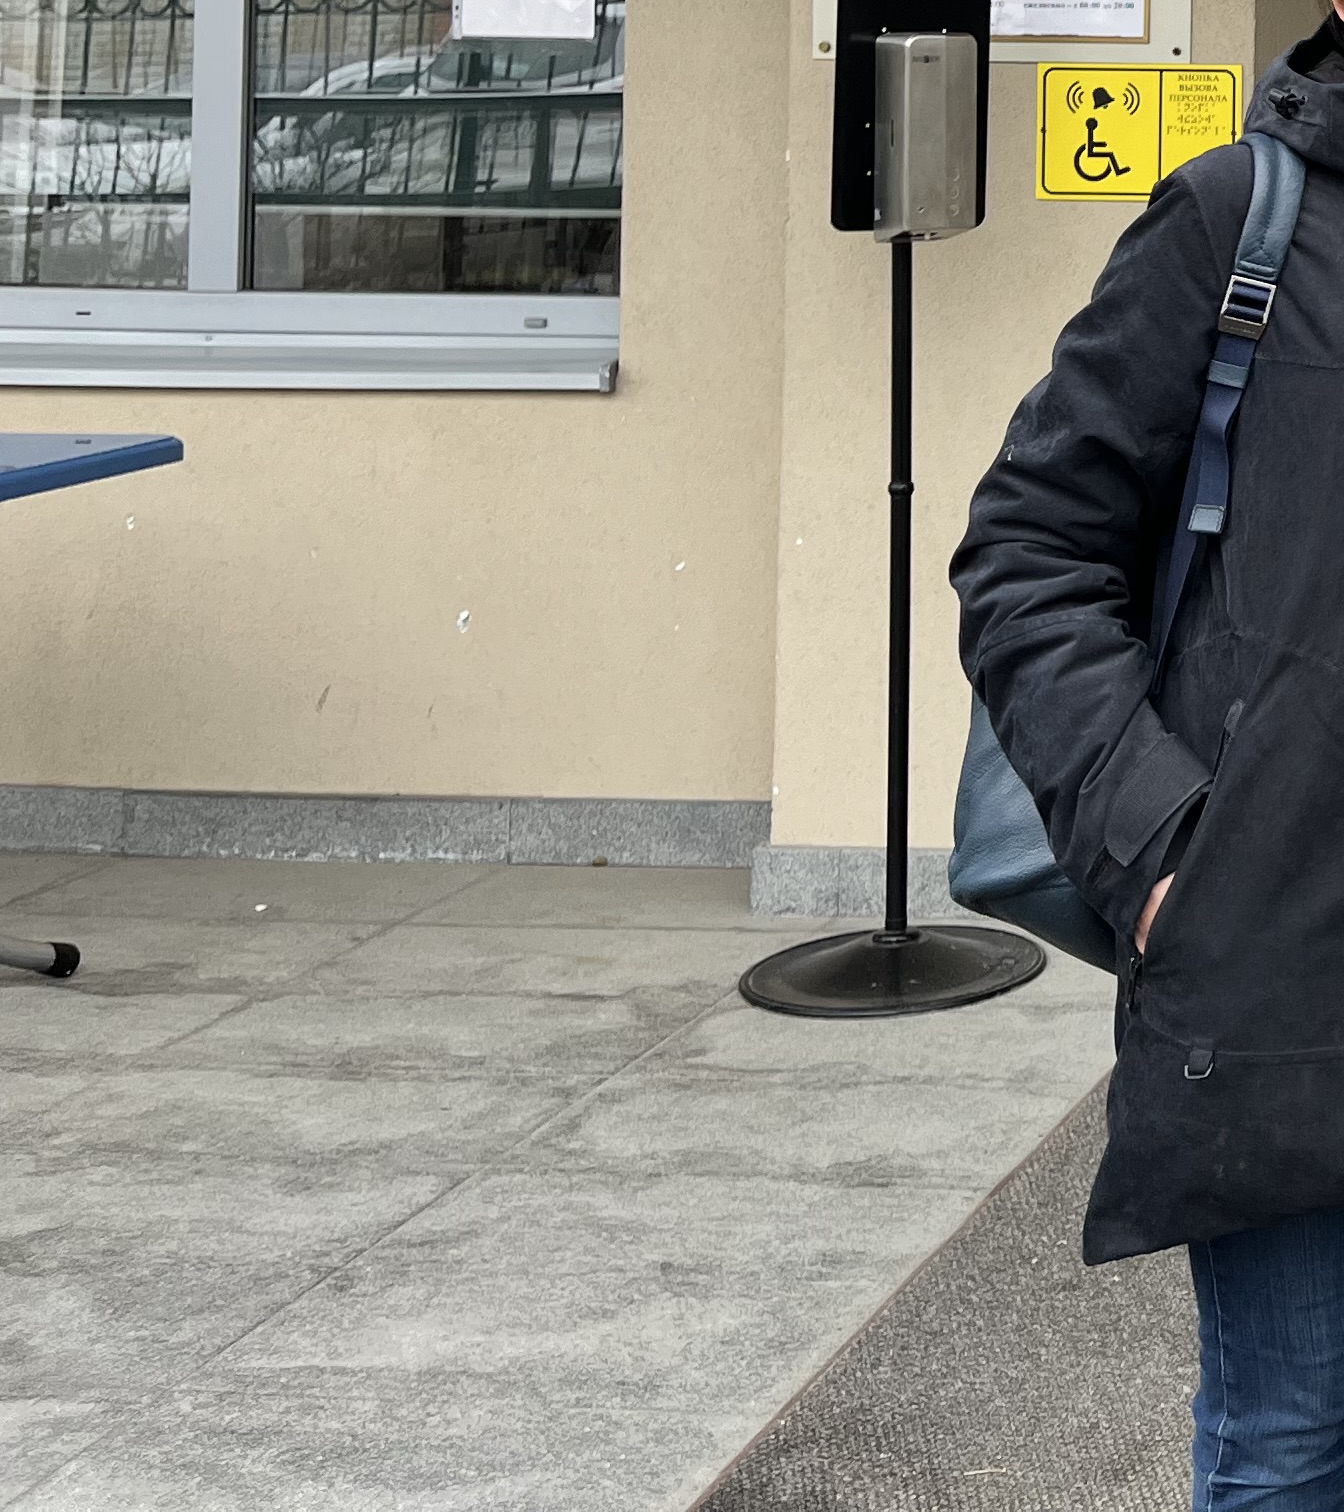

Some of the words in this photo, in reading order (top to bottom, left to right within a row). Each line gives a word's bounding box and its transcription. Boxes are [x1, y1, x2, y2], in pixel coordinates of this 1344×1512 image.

[1178, 74, 1220, 82] КНОПКА
[1179, 84, 1218, 92] ВЫЗОВА
[1169, 94, 1228, 102] ПЕРСОНАЛА
